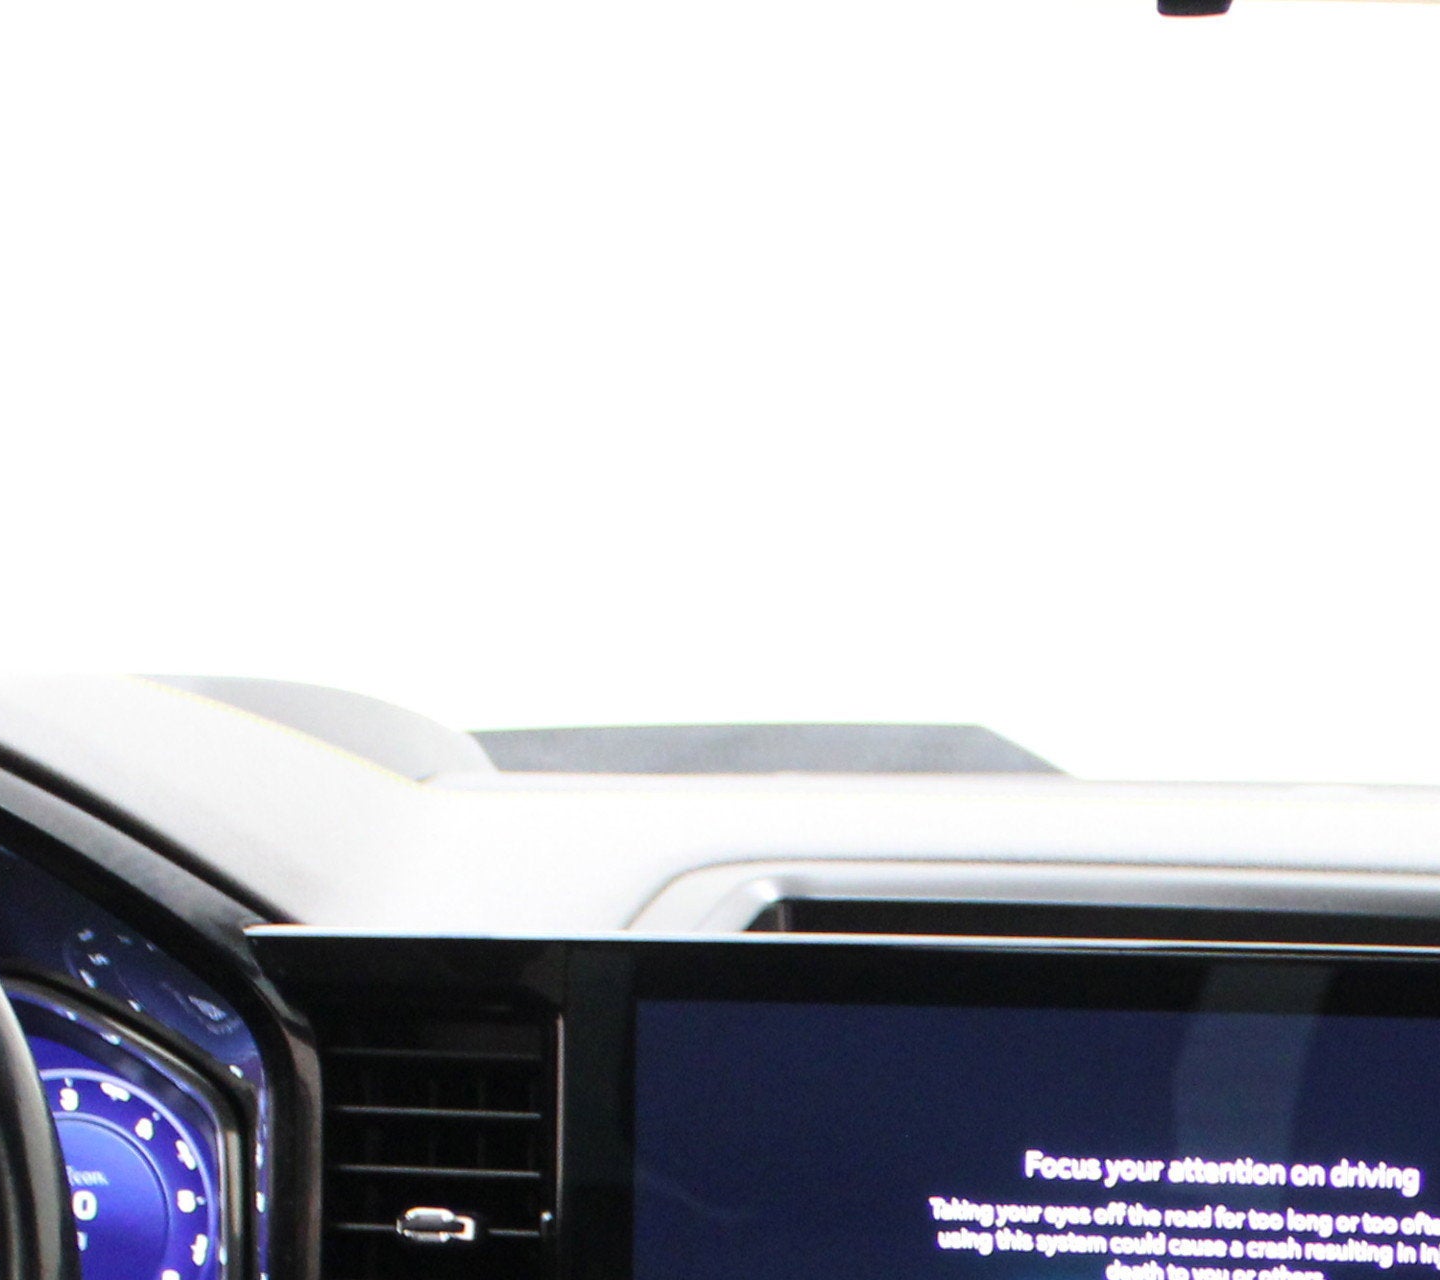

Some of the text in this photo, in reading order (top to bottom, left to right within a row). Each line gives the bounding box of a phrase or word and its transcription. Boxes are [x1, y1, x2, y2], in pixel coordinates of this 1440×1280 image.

[1024, 1150, 1421, 1197] Focus your attention on driving
[928, 1197, 994, 1227] Taking
[995, 1204, 1042, 1227] your
[1043, 1205, 1091, 1229] eyes
[1093, 1201, 1127, 1225] off
[1127, 1202, 1162, 1227] the
[1164, 1205, 1212, 1229] road
[1214, 1205, 1246, 1230] for
[1247, 1208, 1284, 1231] too
[1286, 1207, 1333, 1238] long
[1335, 1214, 1360, 1233] or
[1361, 1212, 1398, 1235] too
[937, 1227, 993, 1256] using
[994, 1227, 1034, 1251] this
[1035, 1231, 1107, 1257] system
[1109, 1231, 1166, 1256] could
[1167, 1238, 1228, 1258] cause
[1229, 1239, 1244, 1259] a
[1246, 1236, 1302, 1260] crash
[1304, 1238, 1394, 1269] resulting
[1396, 1241, 1417, 1264] in
